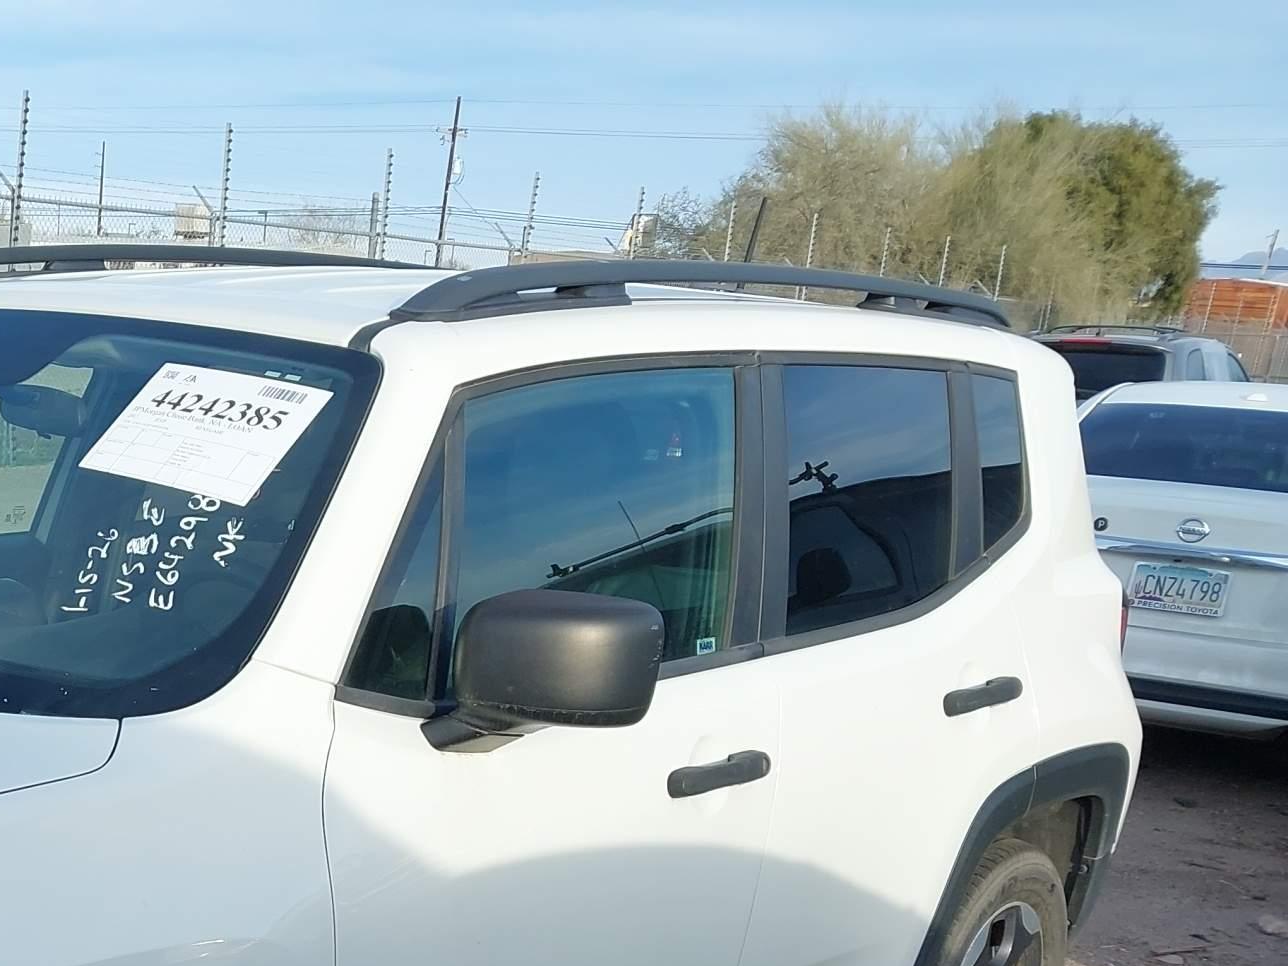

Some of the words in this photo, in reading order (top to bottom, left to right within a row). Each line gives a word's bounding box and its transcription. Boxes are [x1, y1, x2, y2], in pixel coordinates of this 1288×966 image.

[151, 388, 289, 431] 44242385
[148, 494, 222, 611] E64298
[1143, 574, 1222, 603] CNZ4798
[1136, 600, 1183, 611] PRECISION
[1186, 605, 1219, 615] TOYOTA
